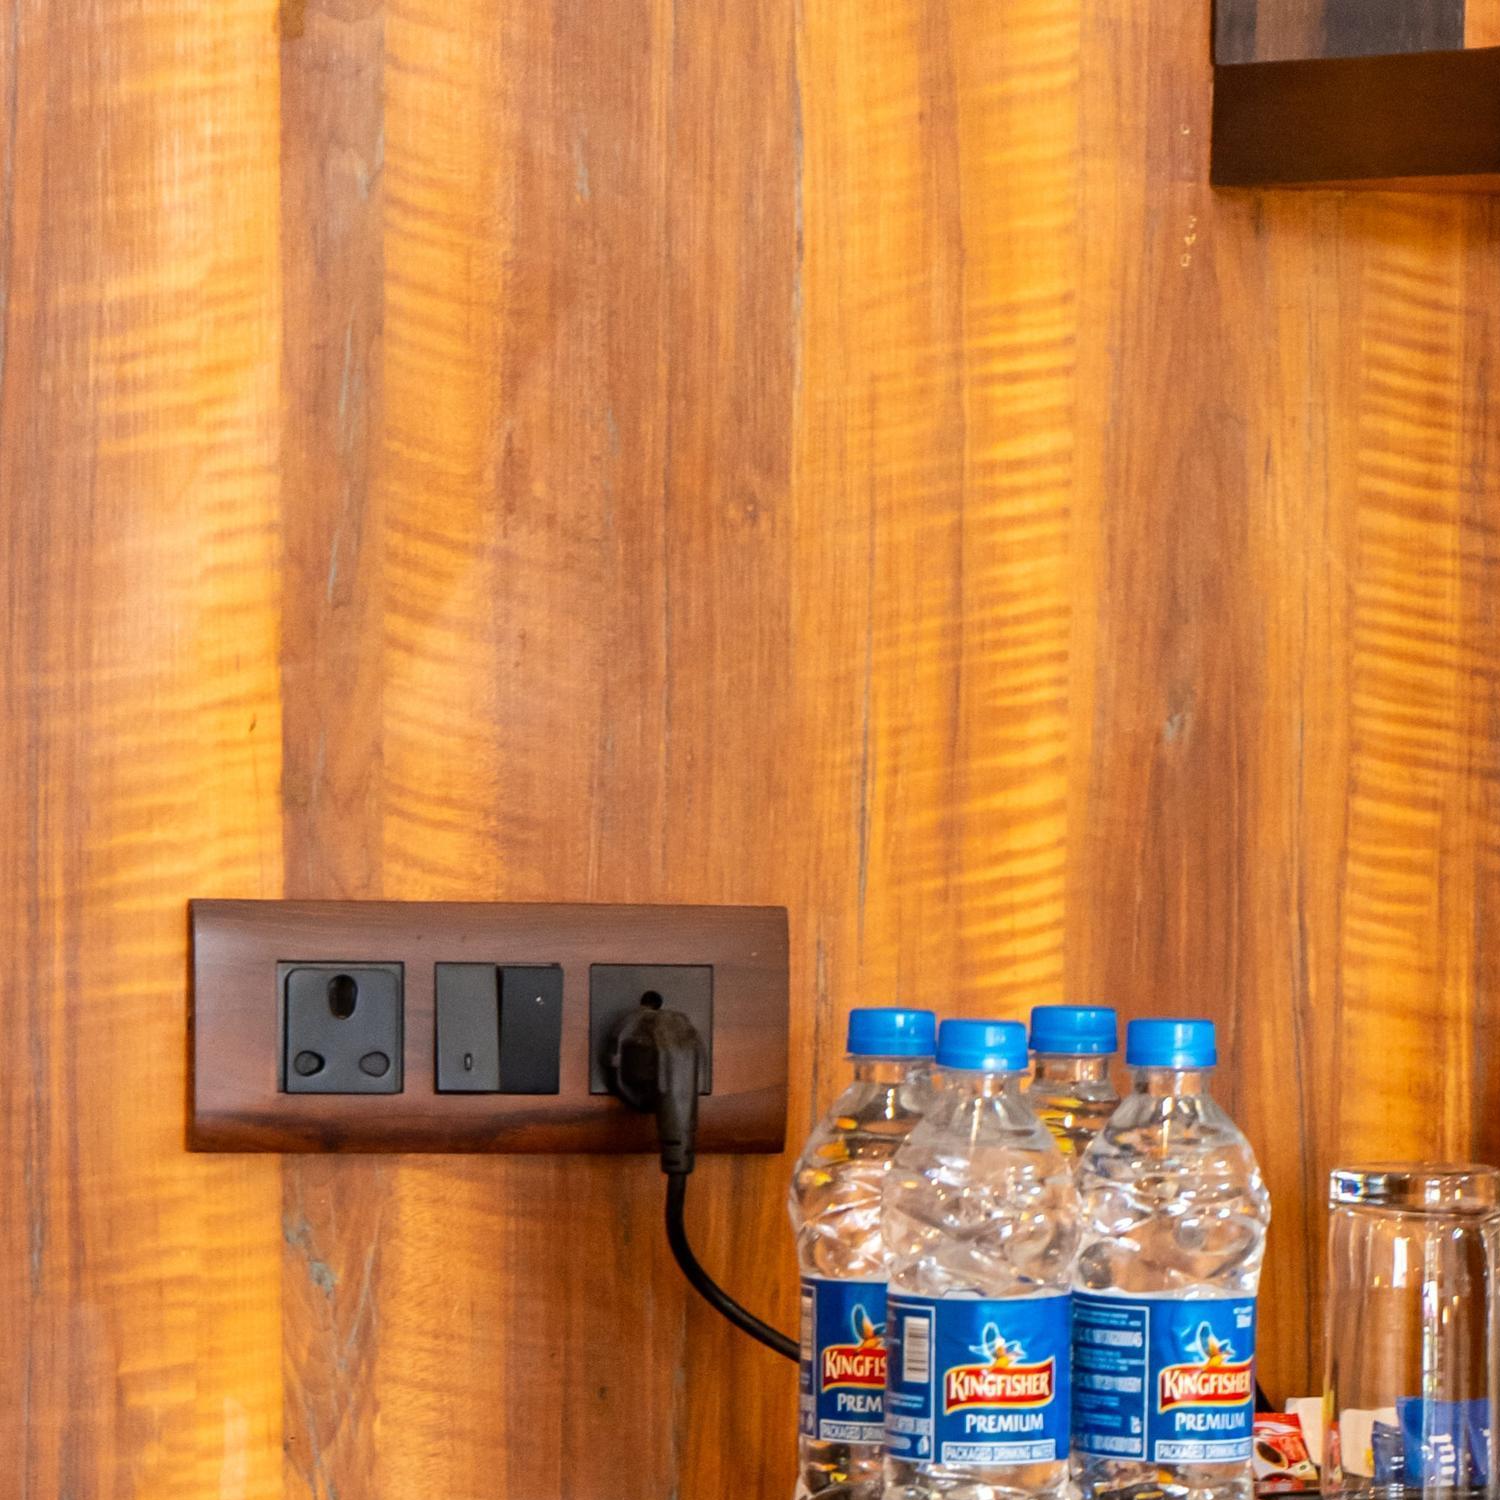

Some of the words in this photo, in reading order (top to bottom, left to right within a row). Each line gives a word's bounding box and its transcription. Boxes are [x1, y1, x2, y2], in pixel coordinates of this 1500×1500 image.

[825, 1350, 887, 1379] KINGFIS
[950, 1370, 1050, 1401] KINGFISHER
[837, 1392, 882, 1413] PREM
[965, 1413, 1044, 1433] PREMIUM
[1175, 1412, 1245, 1432] PREMIUM
